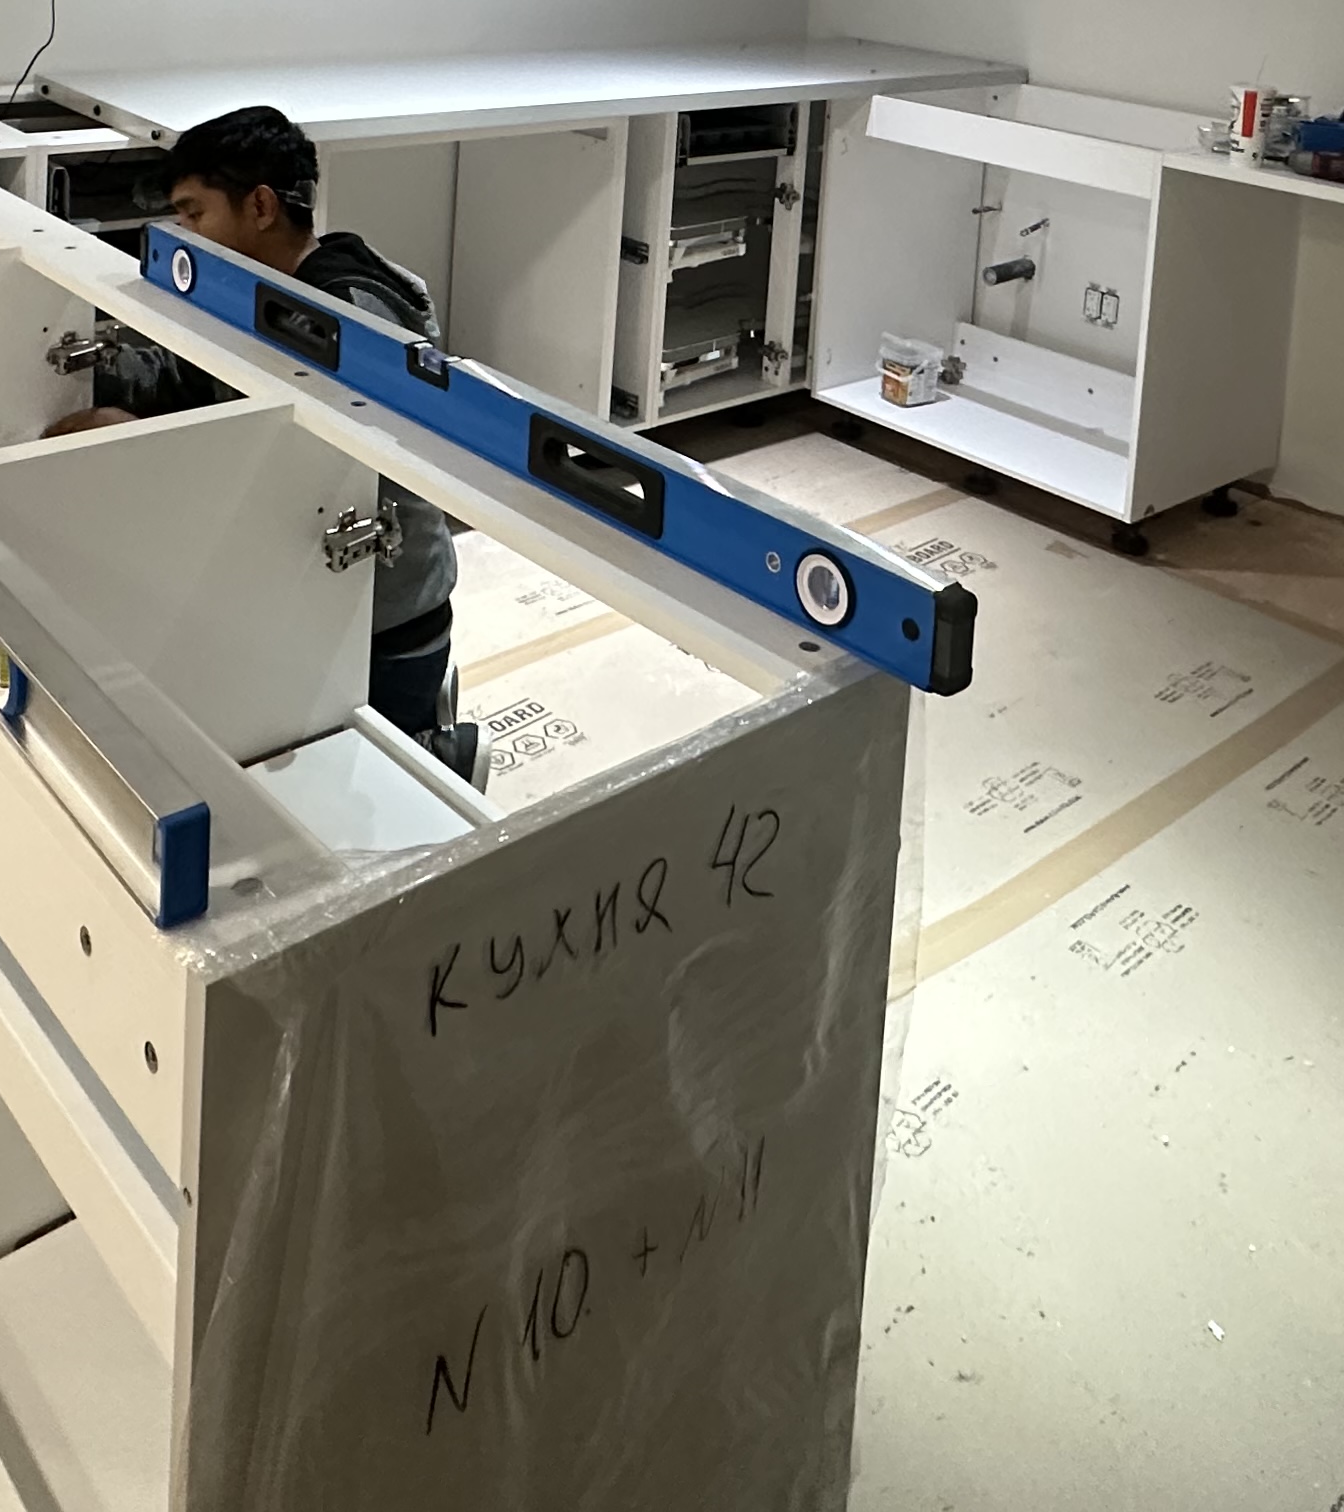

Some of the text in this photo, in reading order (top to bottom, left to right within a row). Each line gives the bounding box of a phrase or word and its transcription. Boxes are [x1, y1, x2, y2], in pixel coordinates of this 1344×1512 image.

[905, 540, 955, 564] BOARD
[487, 701, 545, 732] OARD
[710, 803, 781, 909] 42
[425, 1303, 488, 1437] N
